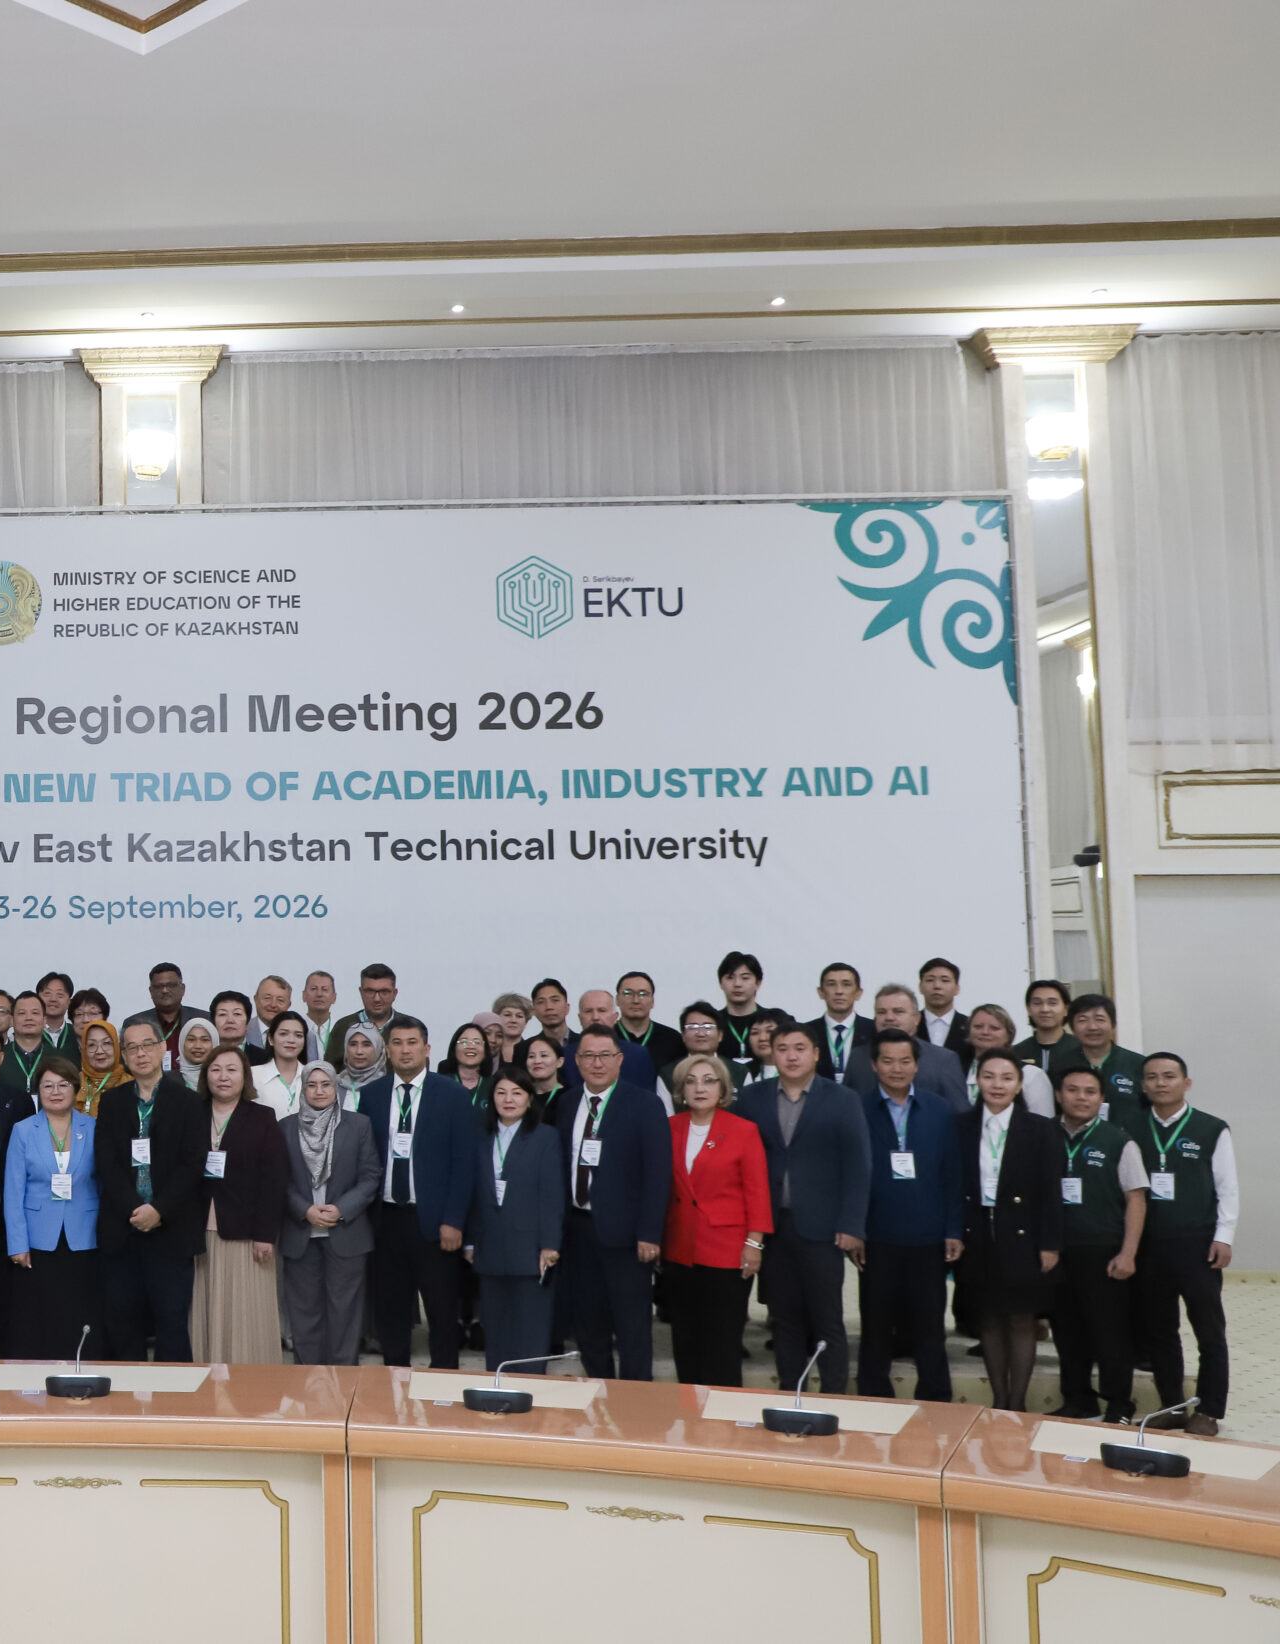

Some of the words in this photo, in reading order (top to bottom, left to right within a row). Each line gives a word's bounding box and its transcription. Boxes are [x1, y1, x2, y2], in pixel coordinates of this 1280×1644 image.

[53, 571, 137, 586] MINISTRY
[142, 570, 167, 585] OF
[172, 569, 251, 585] SCIENCE
[256, 568, 297, 583] AND
[592, 575, 635, 584] Serikbayev
[53, 597, 120, 612] HIGHER
[126, 595, 231, 611] EDUCATION
[236, 595, 261, 610] OF
[266, 594, 301, 609] THE
[583, 586, 684, 618] EKTU
[53, 622, 139, 638] REPUBLIC
[144, 622, 169, 637] OF
[175, 620, 299, 637] KAZAKHSTAN
[16, 692, 228, 745] Regional
[248, 691, 458, 742] Meeting
[477, 691, 604, 731] 2026
[3, 773, 97, 803] NEW
[110, 772, 232, 802] TRIAD
[245, 771, 299, 802] OF
[311, 769, 548, 807] ACADEMIA,
[561, 767, 769, 800] INDUSTRY
[781, 766, 874, 798] AND
[888, 765, 929, 796] AI
[33, 833, 113, 864] East
[127, 830, 351, 863] Kazakhstan
[364, 828, 555, 862] Technical
[569, 827, 769, 868] University
[68, 893, 243, 925] September,
[253, 894, 329, 919] 2026
